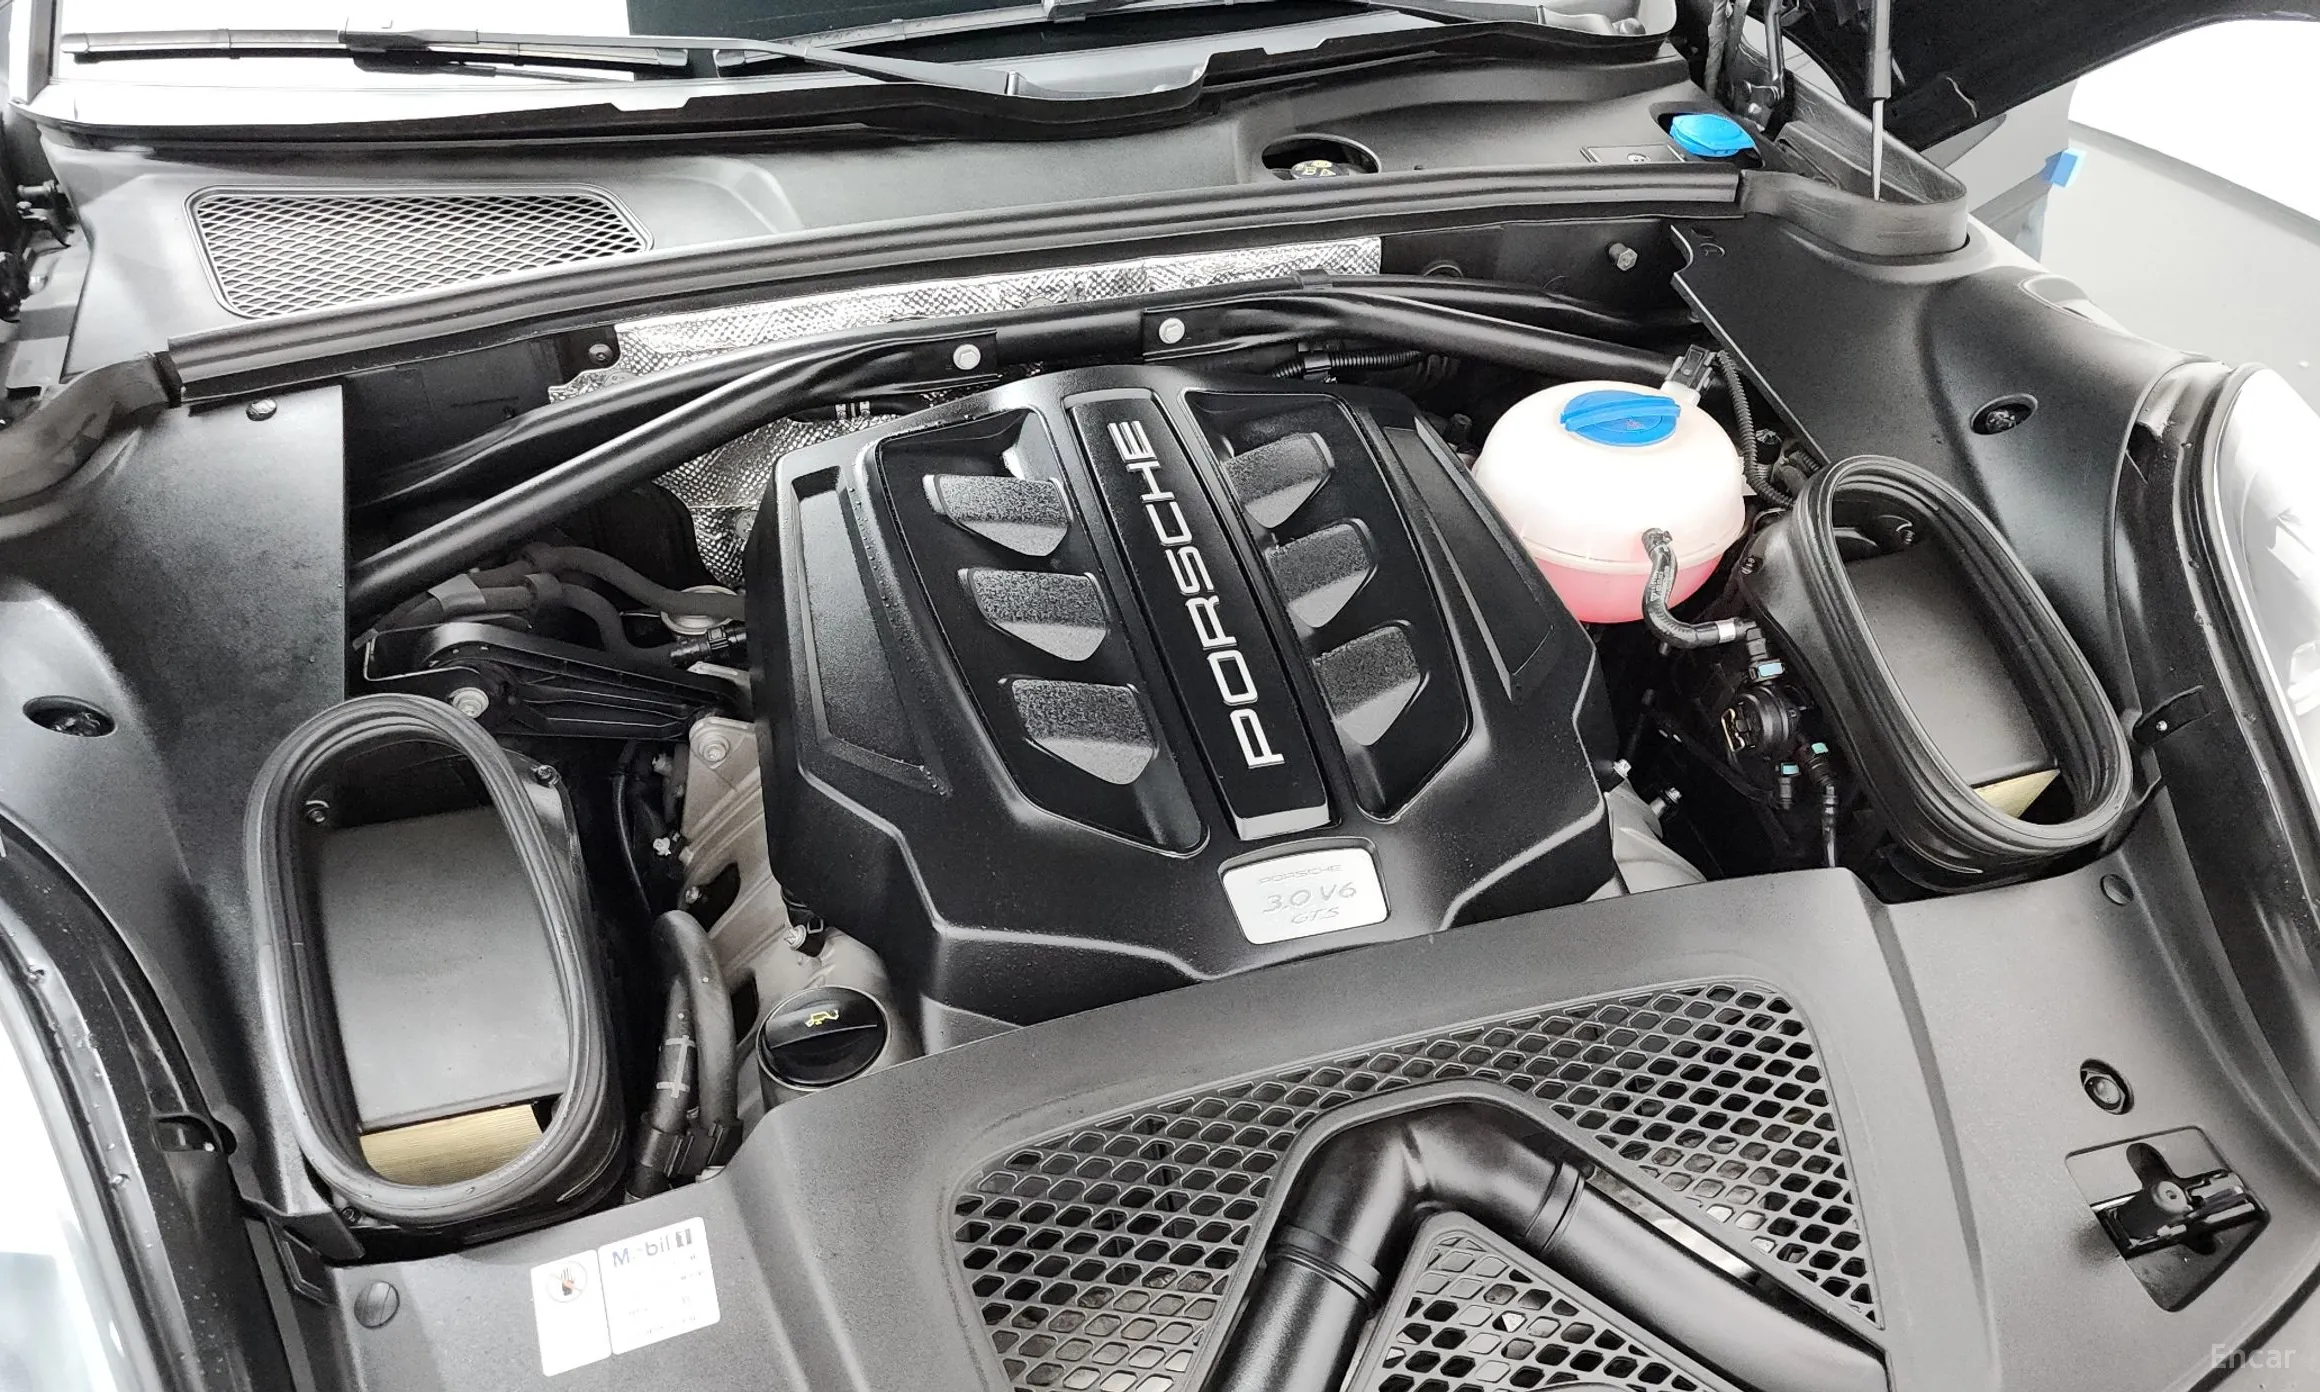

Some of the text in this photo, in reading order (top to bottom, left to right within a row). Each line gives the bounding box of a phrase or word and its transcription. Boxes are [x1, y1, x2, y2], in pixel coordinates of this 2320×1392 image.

[1107, 420, 1285, 769] PORSCHE
[1258, 864, 1343, 885] PORSCHE
[1262, 882, 1357, 913] 3.0 V6
[1291, 907, 1340, 925] GTS
[612, 1235, 671, 1269] Mbil
